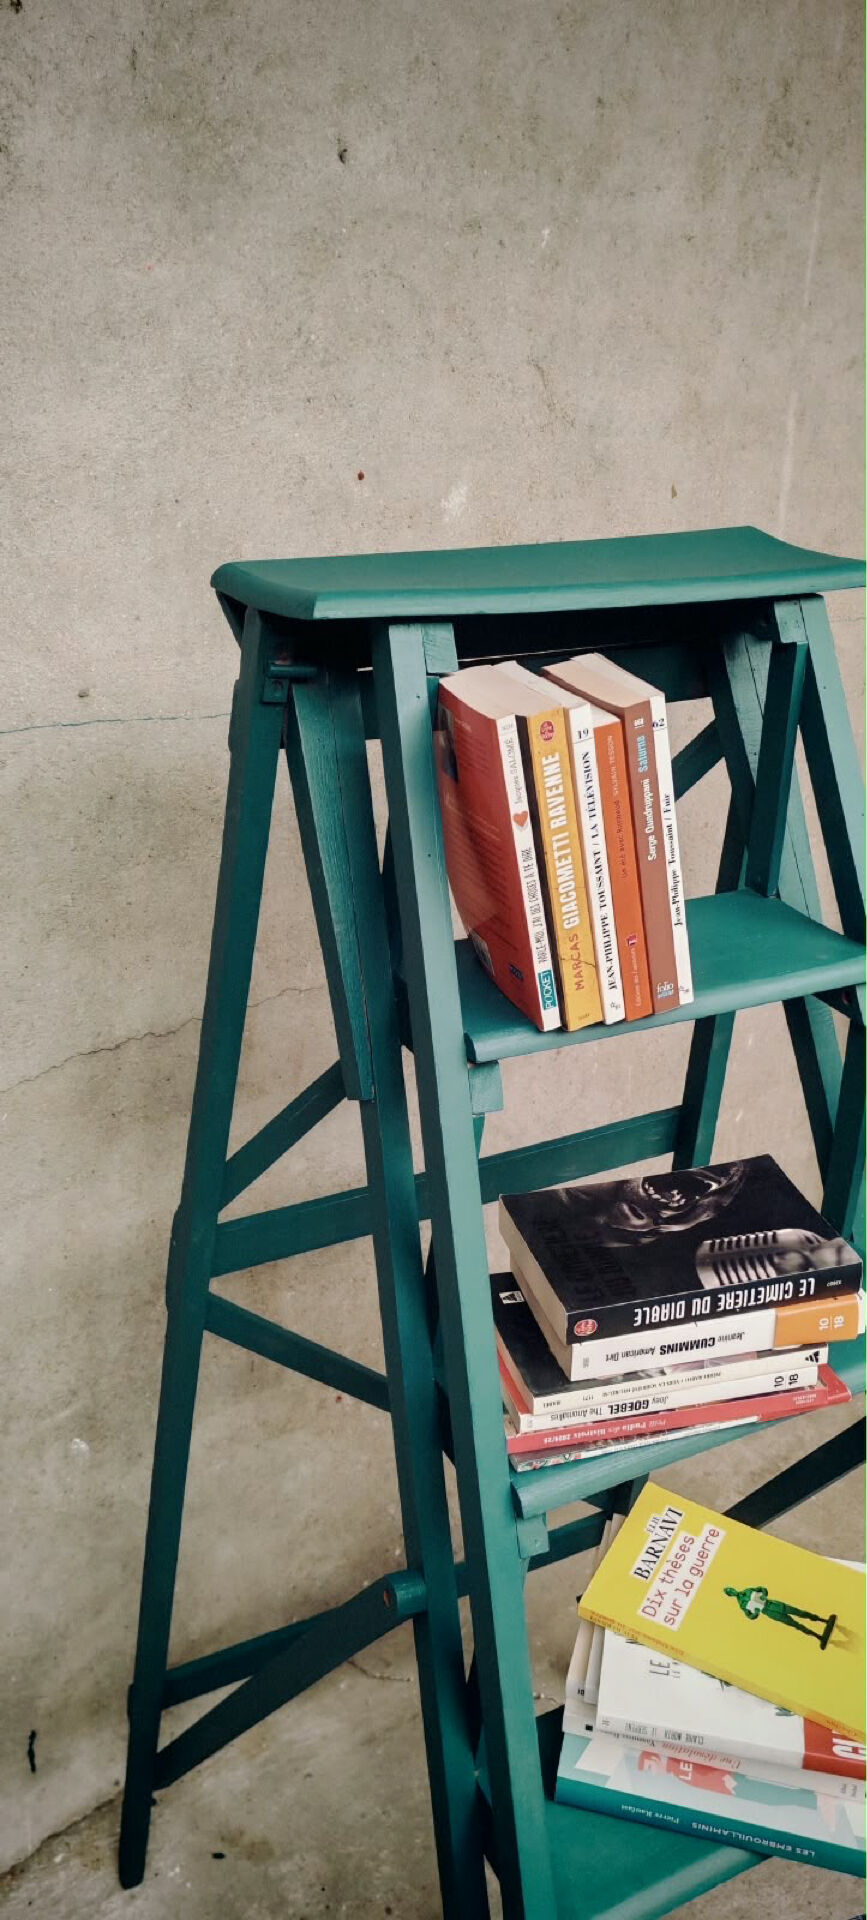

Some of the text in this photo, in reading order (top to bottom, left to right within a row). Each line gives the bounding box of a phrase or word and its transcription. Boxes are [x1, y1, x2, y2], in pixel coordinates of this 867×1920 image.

[576, 727, 589, 739] 19
[634, 735, 648, 773] Saturne
[541, 751, 567, 828] RAVENNE
[578, 750, 597, 820] TÉLÉVISION
[589, 822, 598, 838] LA
[646, 834, 658, 861] Serge
[551, 832, 581, 929] GIACOMETTI
[593, 849, 607, 910] TOUSSAINT
[567, 933, 584, 990] MARCAS
[599, 912, 617, 990] JEAN-PHILIPPE
[540, 970, 557, 1008] POCKET
[656, 981, 673, 993] folio
[633, 1277, 816, 1327] LE CIMETIÈRE DU DIABLE
[604, 1331, 745, 1362] Jeanine CUMMINS American Dirt
[588, 1406, 602, 1416] The
[607, 1398, 650, 1414] GOEBEL
[633, 1507, 684, 1580] BARNAVI
[641, 1535, 695, 1617] Dix thèses
[664, 1528, 720, 1626] sur la guerre
[648, 1659, 670, 1676] LE
[678, 1762, 692, 1780] LE
[653, 1812, 680, 1824] Pierre
[690, 1821, 792, 1851] EMBROUILLAMINIS
[794, 1846, 815, 1857] LES
